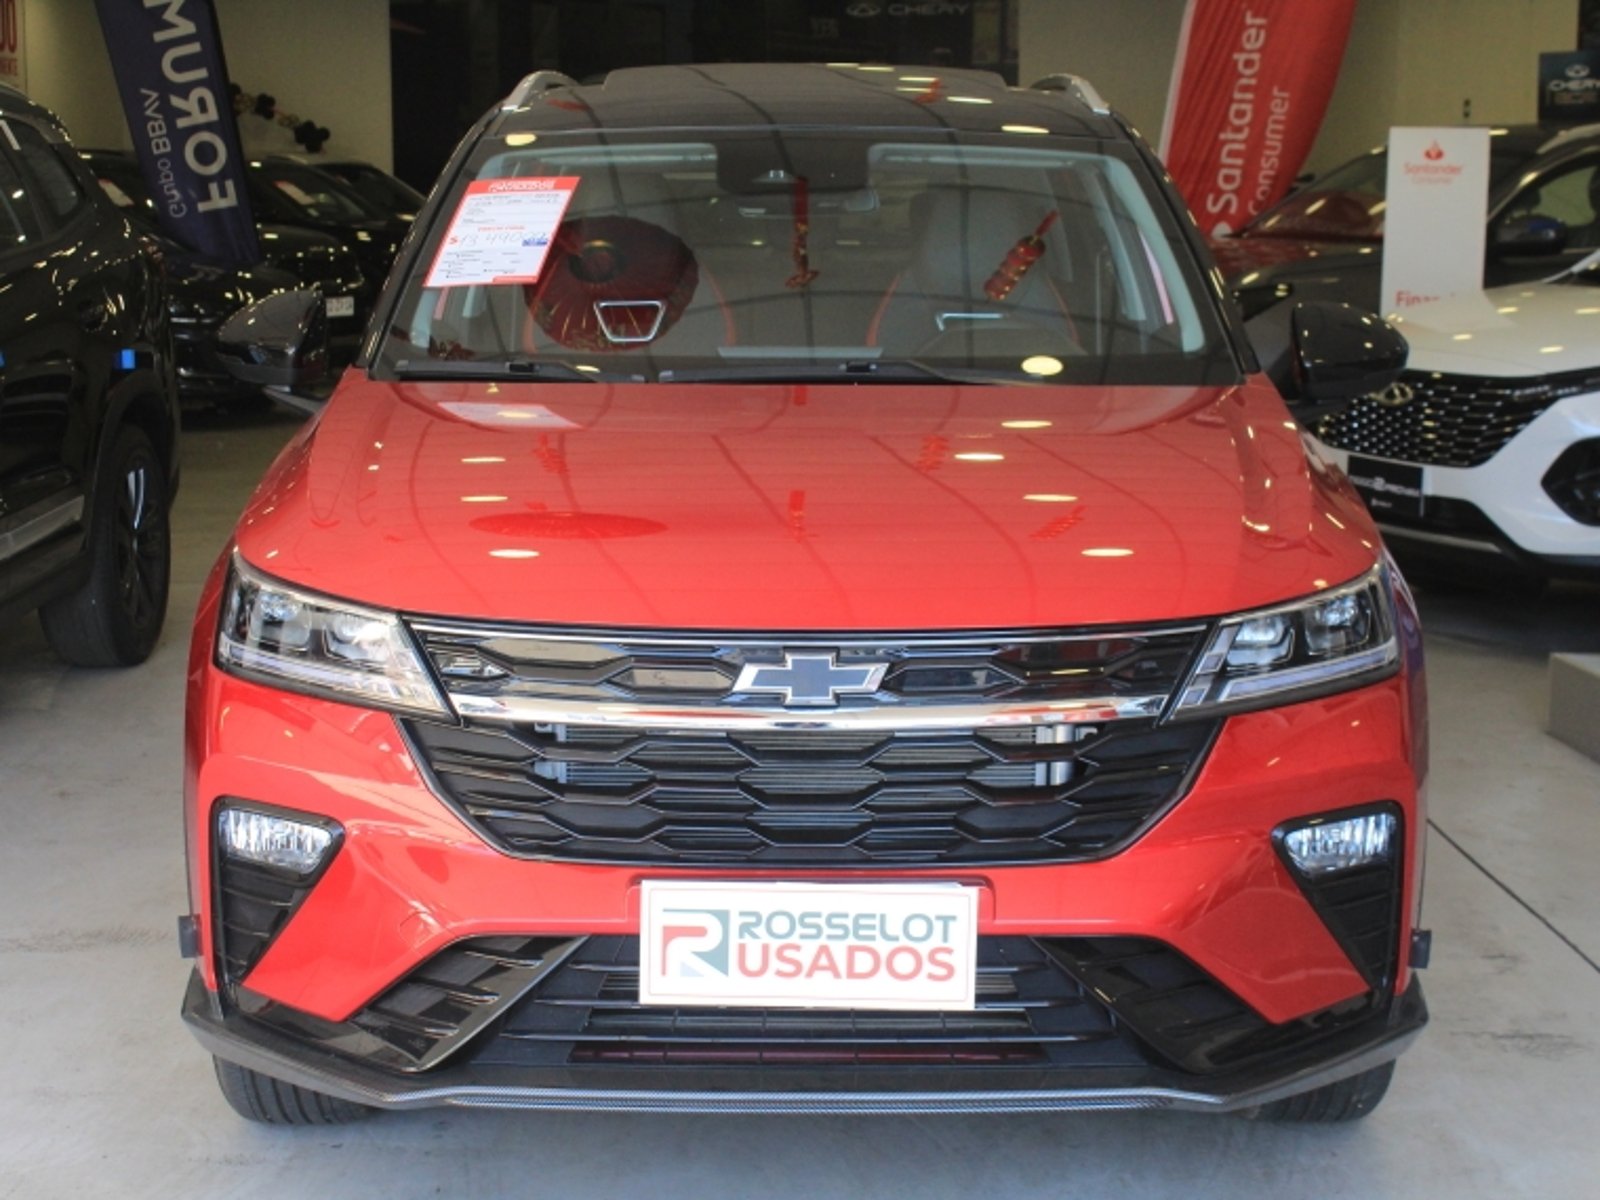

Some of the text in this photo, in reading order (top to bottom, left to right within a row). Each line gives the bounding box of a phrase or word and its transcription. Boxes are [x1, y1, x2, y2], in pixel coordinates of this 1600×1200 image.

[1206, 11, 1268, 214] Santander
[738, 910, 957, 943] ROSSELOT
[738, 943, 956, 982] USADOS
